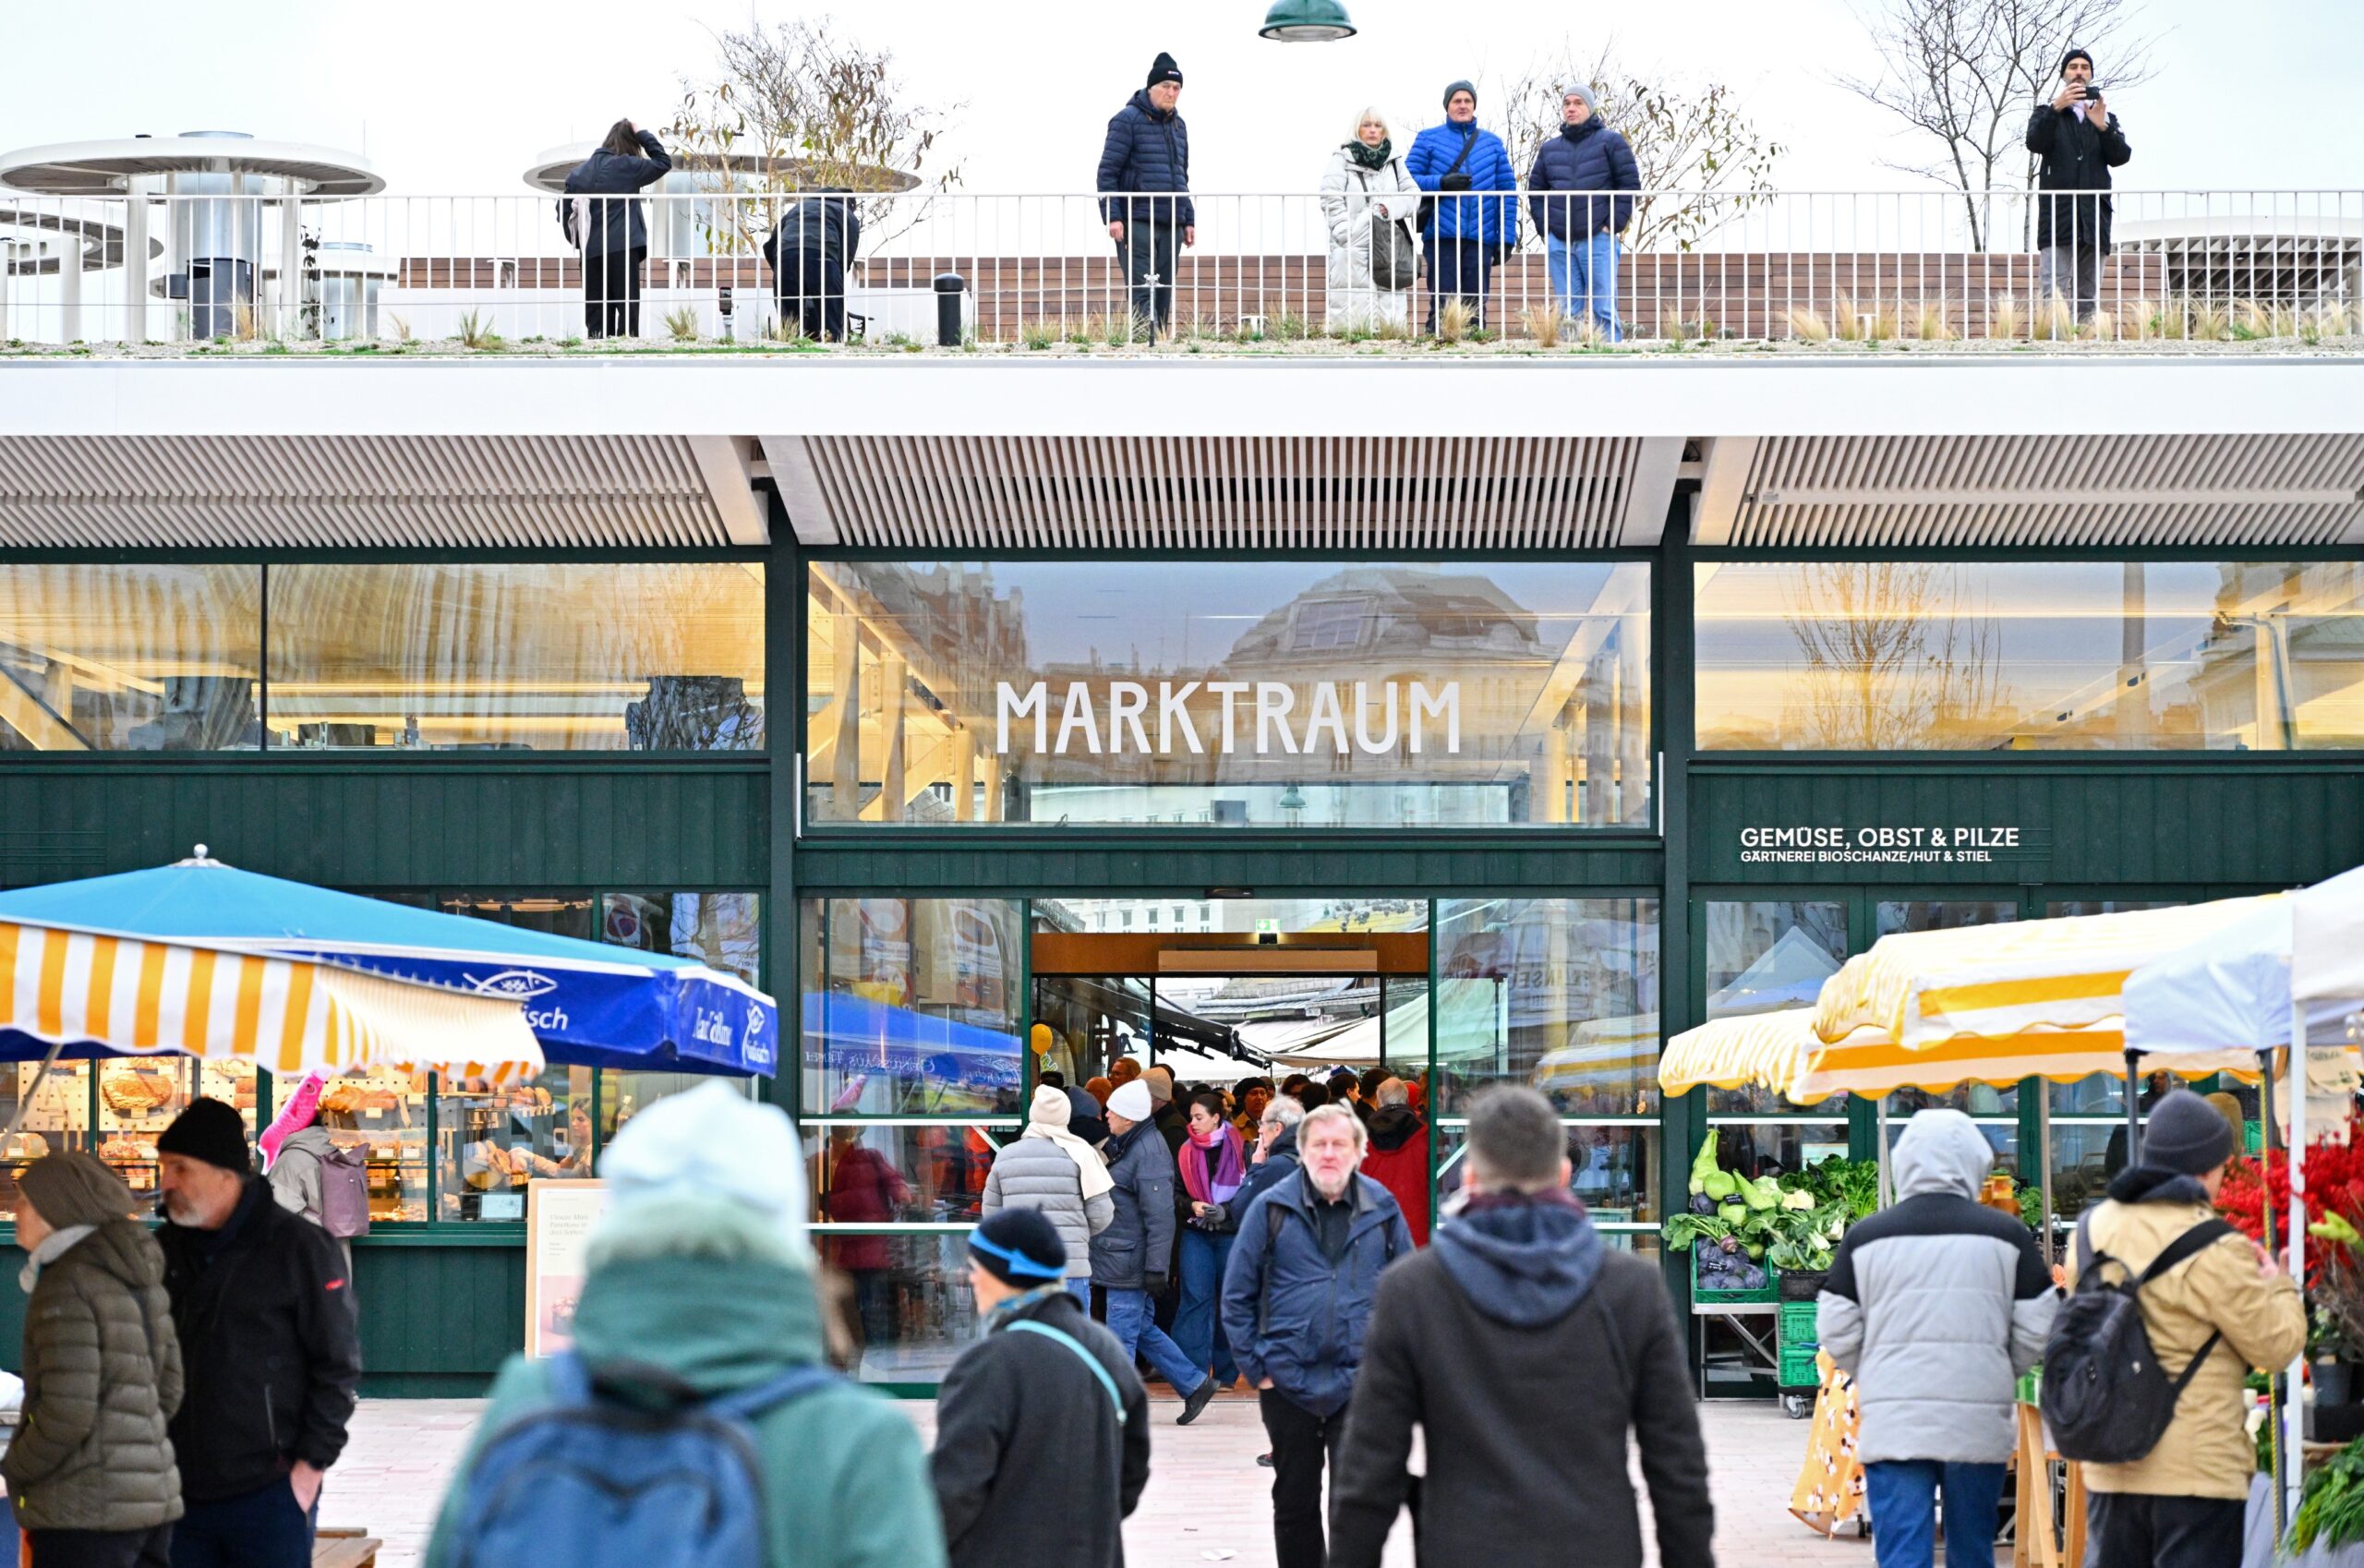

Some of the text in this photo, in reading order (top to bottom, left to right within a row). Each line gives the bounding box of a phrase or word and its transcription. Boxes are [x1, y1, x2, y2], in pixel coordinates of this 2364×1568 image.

[996, 681, 1460, 754] MARKTRAUM
[1740, 826, 2020, 850] GEMÜSE, OBST & PILZE
[1740, 849, 1993, 863] GÄRTNEREI BIOSCHANZE/HUT & STIEL
